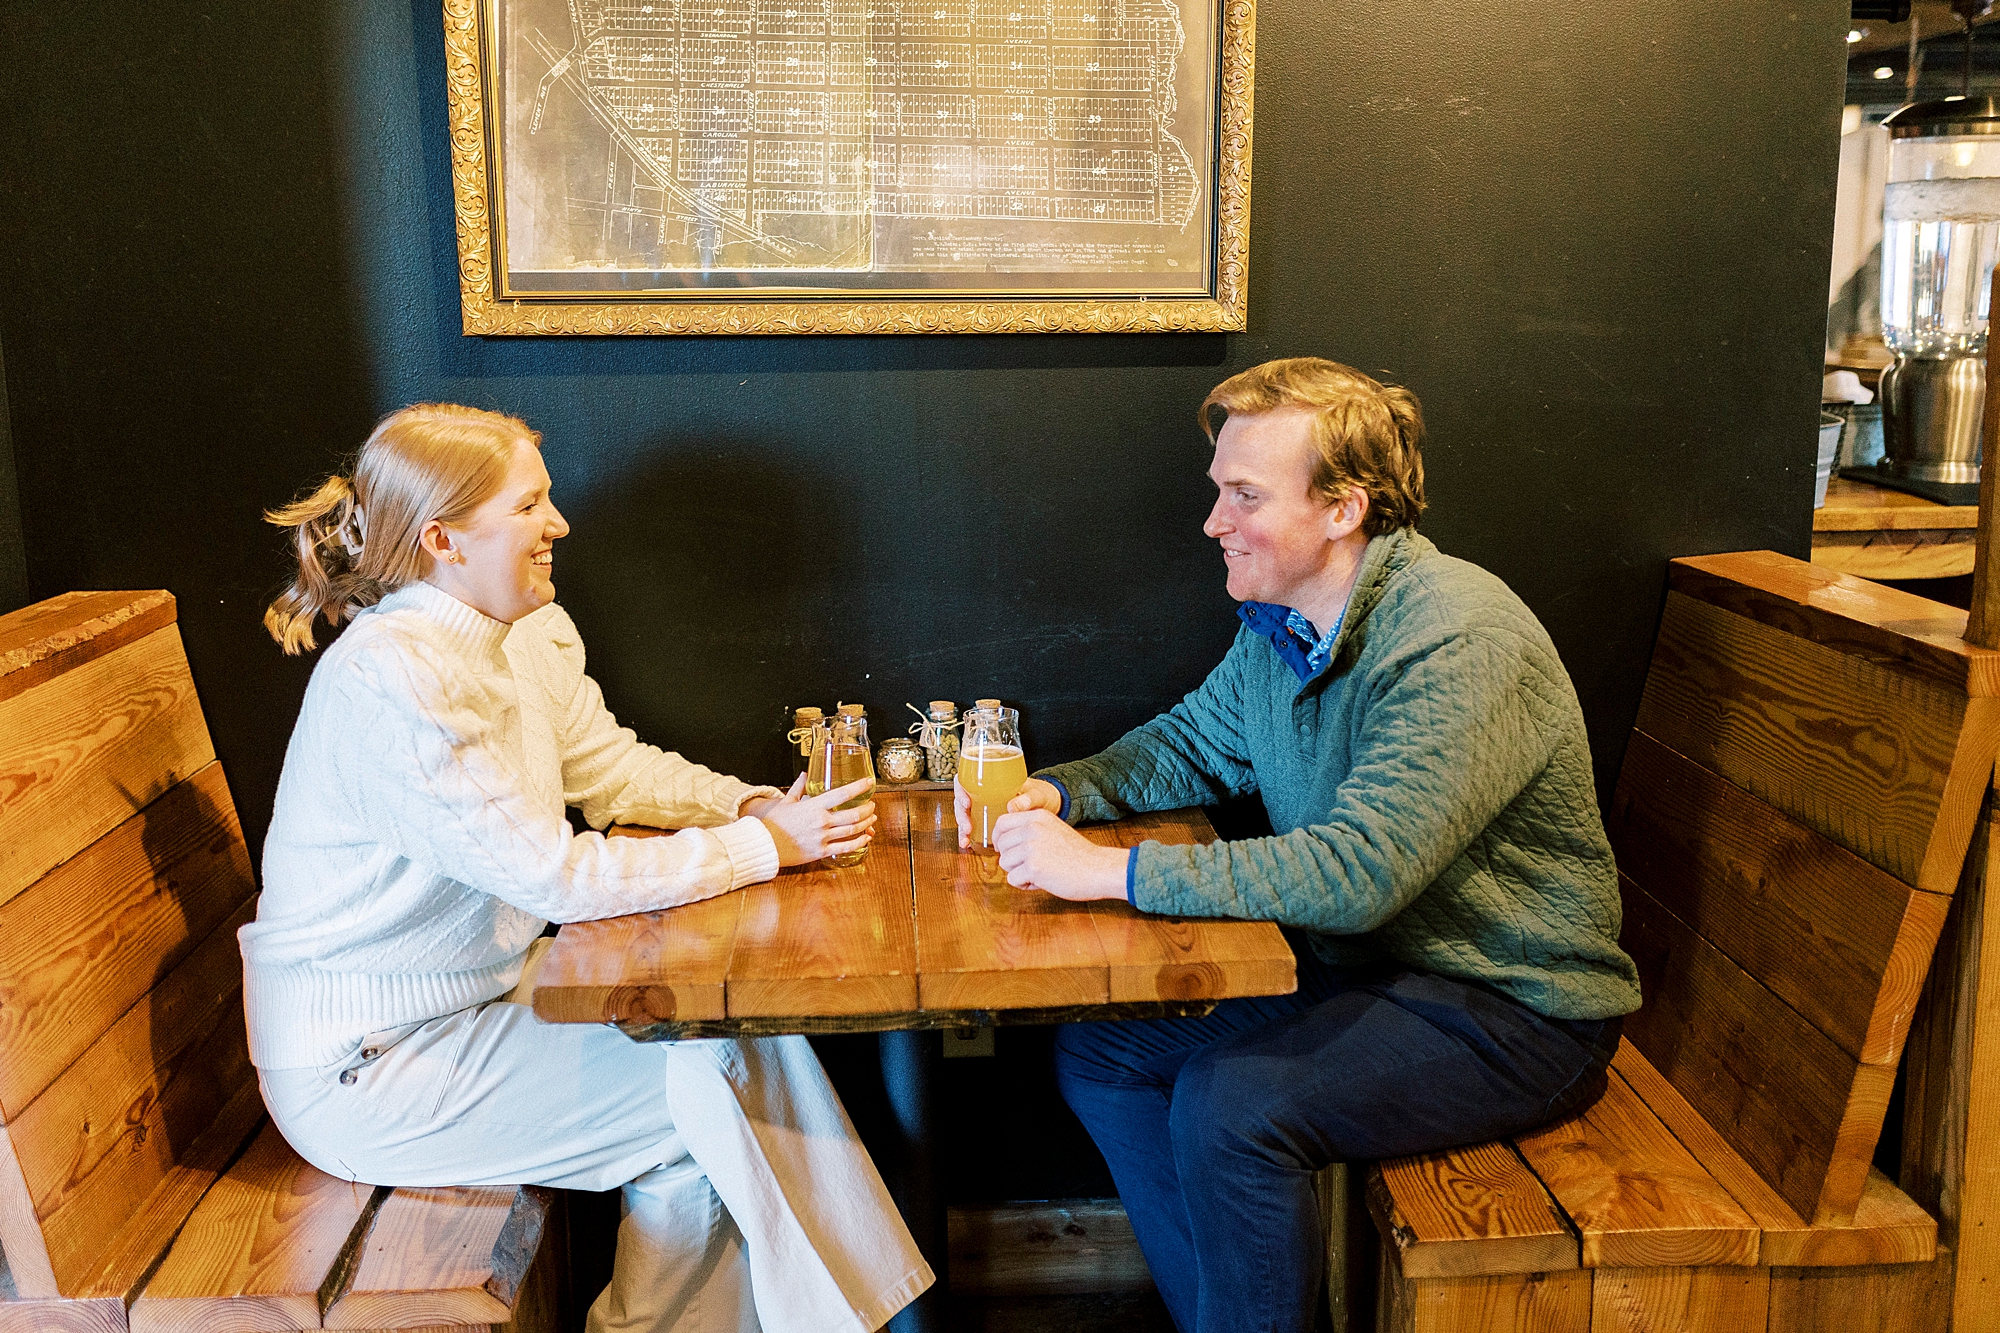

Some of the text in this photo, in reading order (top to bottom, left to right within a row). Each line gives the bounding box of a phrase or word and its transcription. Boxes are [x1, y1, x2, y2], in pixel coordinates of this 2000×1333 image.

[785, 9, 797, 18] 20
[934, 10, 946, 19] 22
[1009, 12, 1021, 21] 23
[1082, 14, 1096, 23] 24
[640, 53, 653, 62] 26
[713, 56, 726, 64] 27
[786, 57, 798, 66] 28
[865, 57, 877, 66] 29
[934, 60, 949, 68] 30
[1010, 61, 1022, 70] 31
[1086, 62, 1099, 72] 32
[640, 103, 654, 113] 33
[713, 105, 726, 115] 34
[530, 103, 542, 135] CLEMENT
[1010, 112, 1023, 121] 38
[1088, 115, 1101, 123] 39
[1092, 167, 1107, 175] 46
[1010, 202, 1023, 210] 52
